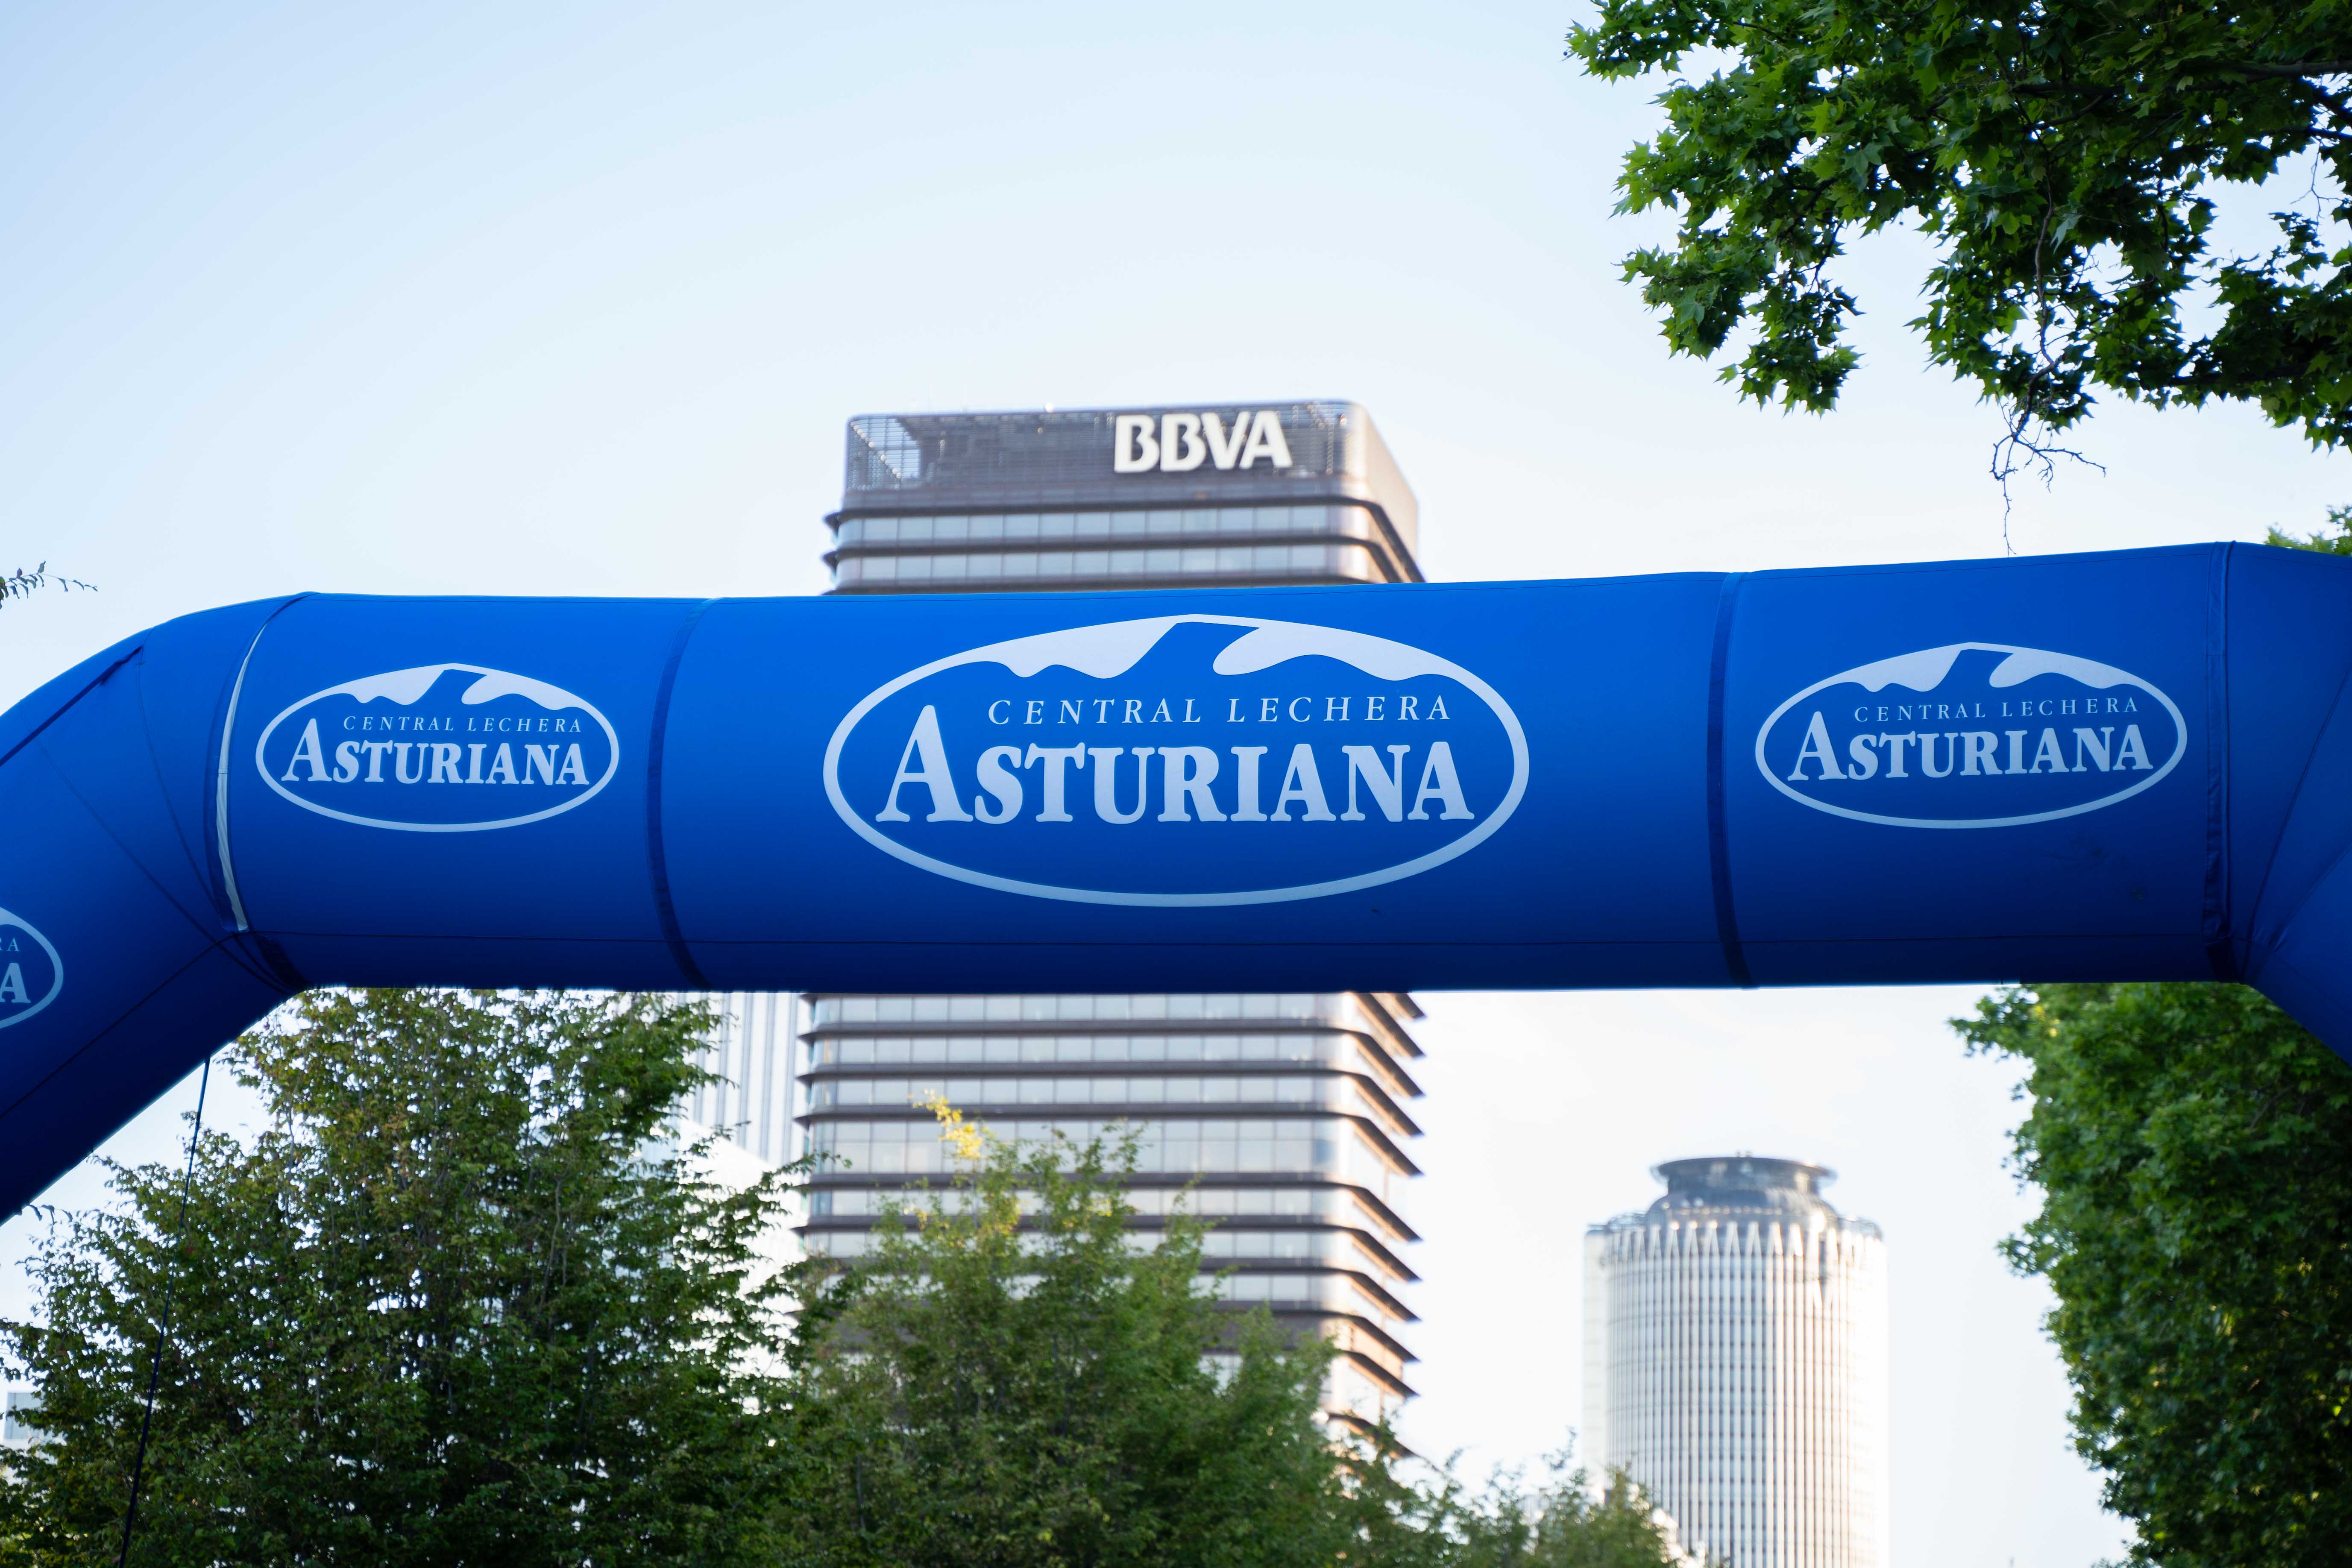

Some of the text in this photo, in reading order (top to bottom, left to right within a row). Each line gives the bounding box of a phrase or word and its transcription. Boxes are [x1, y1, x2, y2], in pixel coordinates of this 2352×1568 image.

[1114, 410, 1293, 473] BBVA
[343, 716, 582, 733] CENTRAL LECHERA
[988, 695, 1451, 725] CENTRAL LECHERA
[1854, 697, 2139, 722] CENTRAL LECHERA
[281, 718, 589, 786] ASTURIANA
[875, 704, 1475, 824] ASTURIANA
[1787, 711, 2154, 781] ASTURIANA
